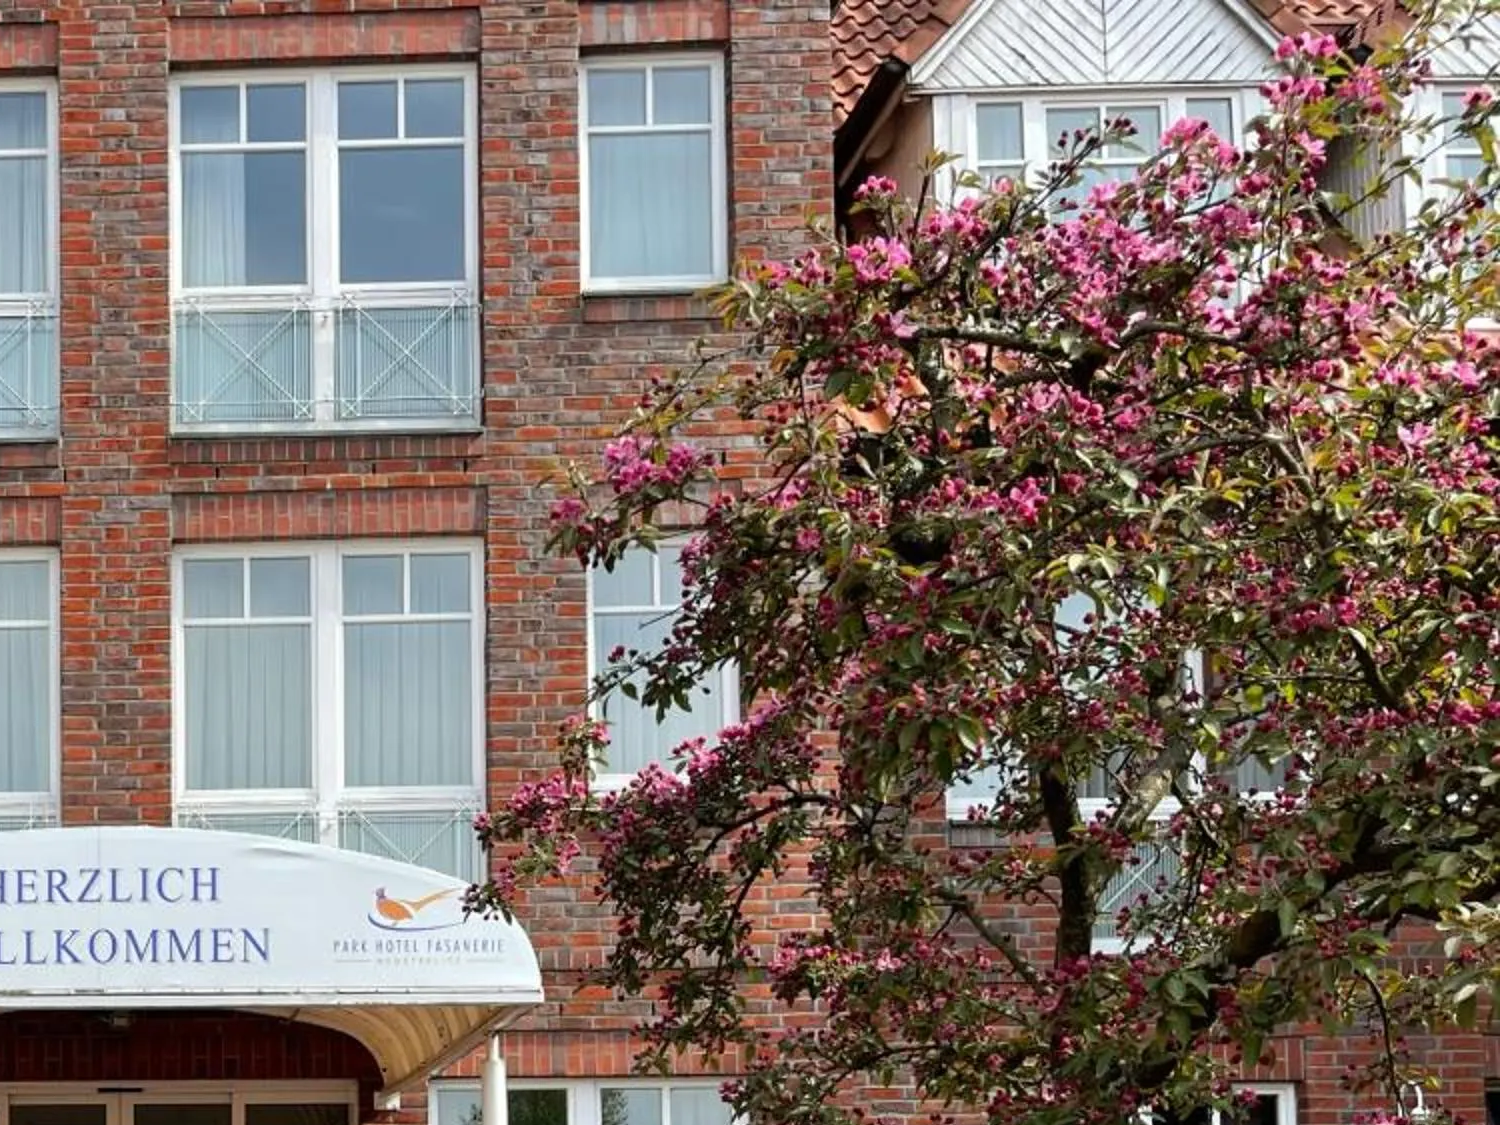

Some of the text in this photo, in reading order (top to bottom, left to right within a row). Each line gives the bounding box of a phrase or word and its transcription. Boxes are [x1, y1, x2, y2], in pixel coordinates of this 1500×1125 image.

[333, 938, 505, 953] PARK HOTEL FASANERIE
